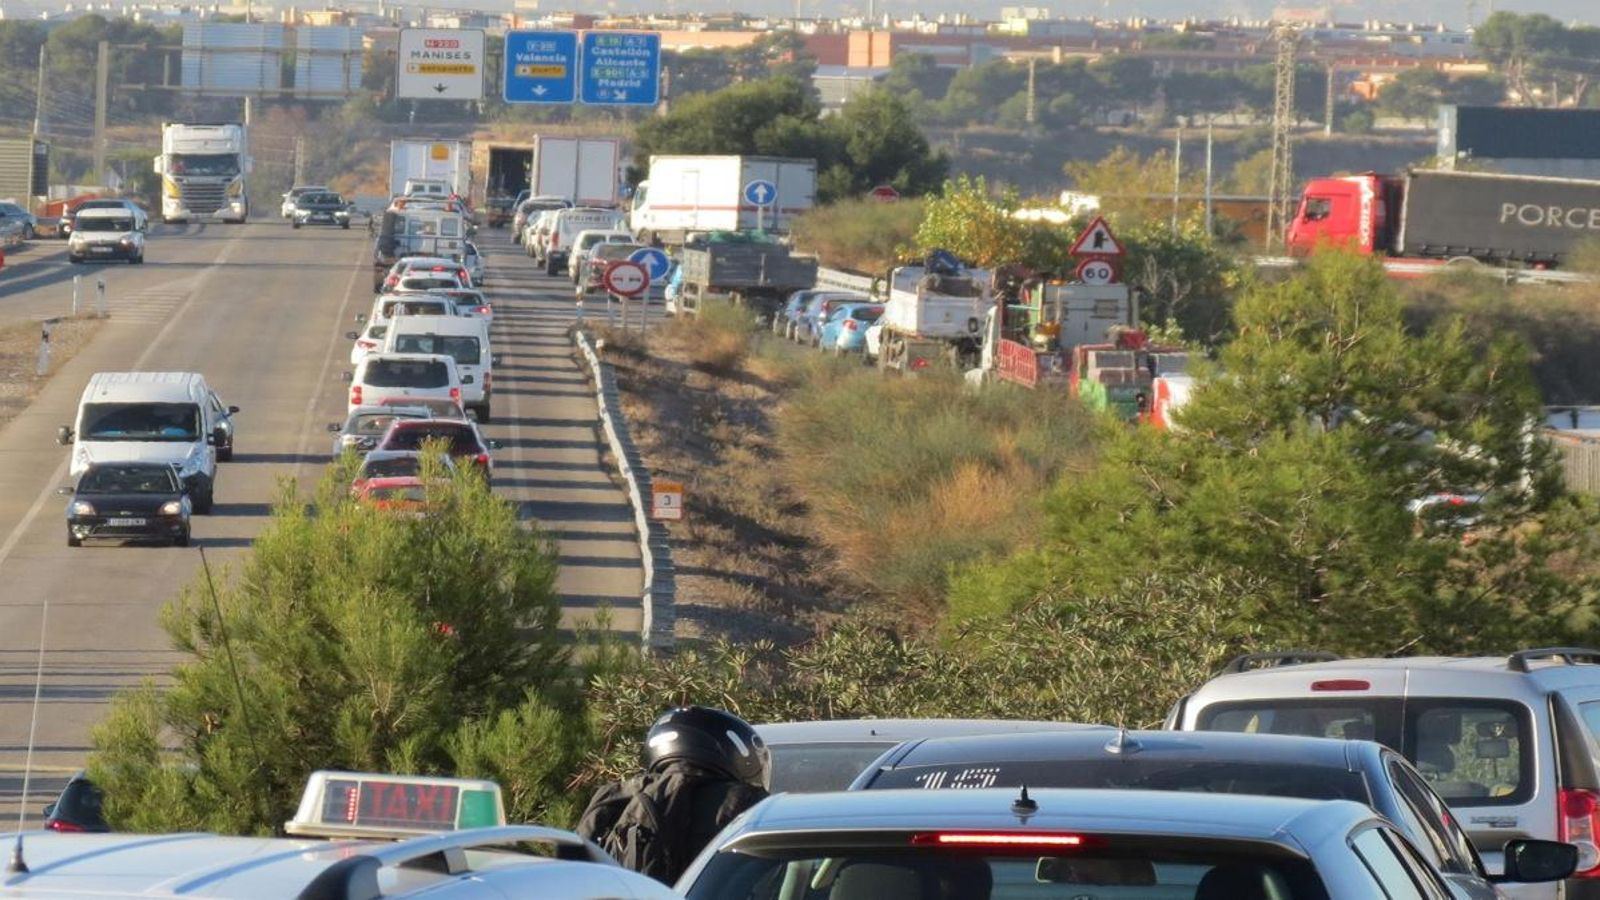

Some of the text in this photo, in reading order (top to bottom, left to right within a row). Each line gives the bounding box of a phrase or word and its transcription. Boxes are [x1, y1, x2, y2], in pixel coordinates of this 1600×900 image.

[411, 51, 471, 59] MANISES
[515, 52, 566, 62] Valencia
[596, 58, 645, 66] Alicante
[598, 79, 640, 88] Madrid
[1085, 268, 1109, 279] 60
[663, 495, 672, 506] 3
[367, 780, 453, 823] TAXI
